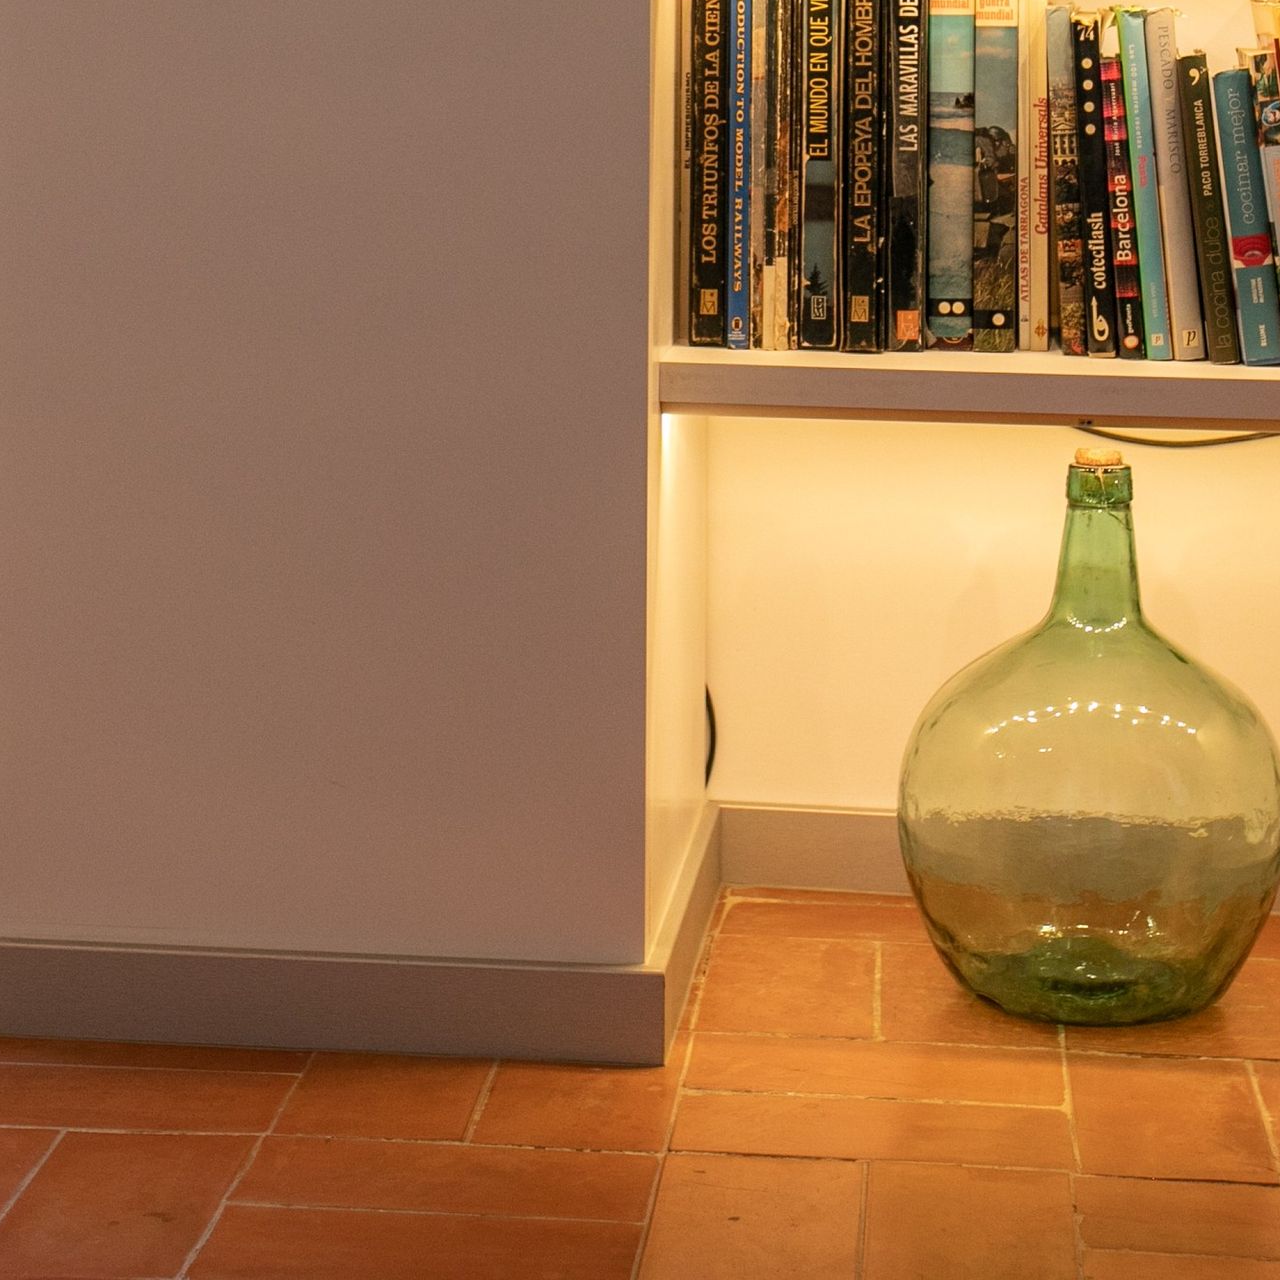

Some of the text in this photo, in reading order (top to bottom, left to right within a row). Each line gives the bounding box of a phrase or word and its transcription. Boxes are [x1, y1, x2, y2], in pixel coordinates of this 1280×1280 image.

[809, 16, 832, 47] QUE
[976, 8, 1014, 20] mundial
[704, 48, 720, 78] LA
[809, 52, 829, 72] EN
[899, 24, 919, 117] MARAVILLAS
[704, 81, 719, 110] DE
[735, 97, 745, 123] TO
[809, 77, 829, 133] MUNDO
[855, 71, 873, 110] DEL
[1157, 25, 1182, 175] PESCADO MARISCO
[734, 127, 745, 192] MODEL
[809, 139, 828, 157] EL
[854, 116, 873, 207] EPOPEYA
[899, 123, 919, 152] LAS
[1193, 99, 1213, 198] PACO TORREBLANCA
[1226, 87, 1256, 225] cocinar mejor
[702, 114, 719, 220] TRIUNFOS
[853, 214, 871, 243] LA
[1019, 176, 1030, 302] ATLAS DE TARRAGONA
[1111, 174, 1132, 262] Barcelona
[701, 222, 718, 265] LOS
[733, 197, 744, 293] RAILWAYS
